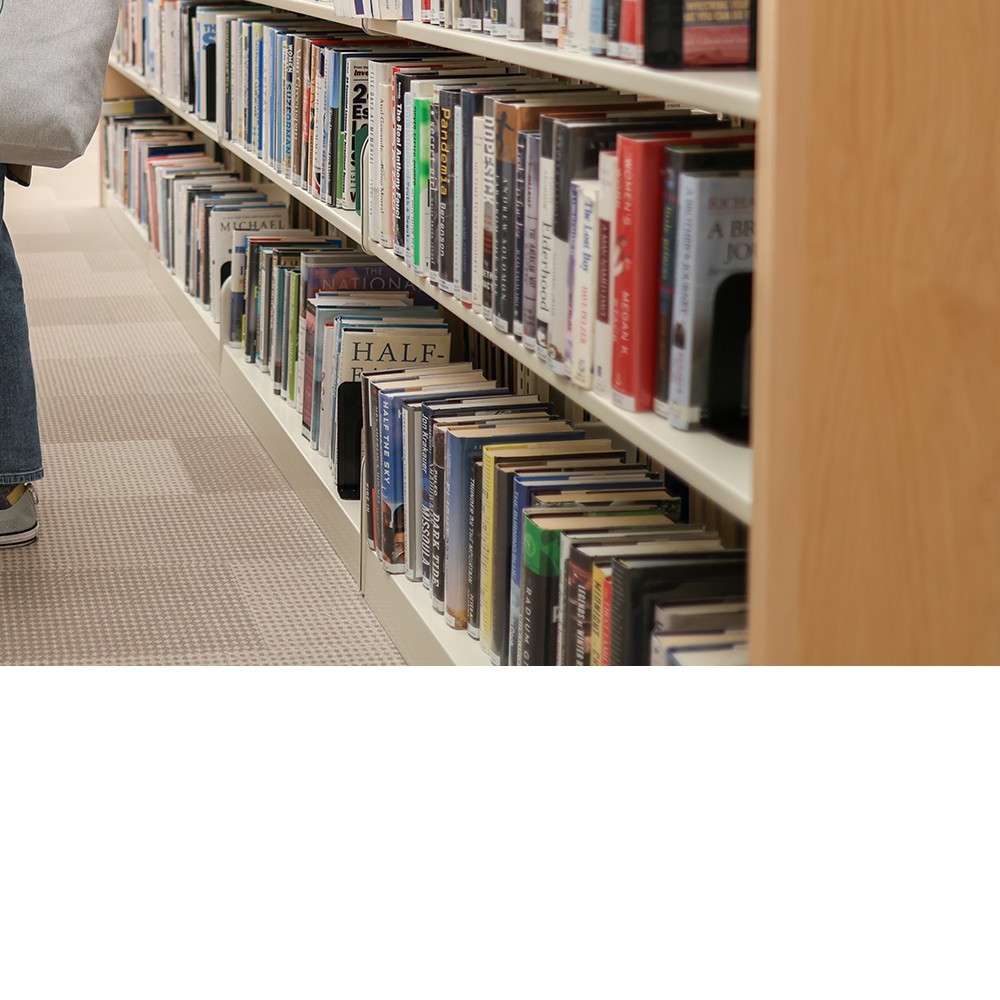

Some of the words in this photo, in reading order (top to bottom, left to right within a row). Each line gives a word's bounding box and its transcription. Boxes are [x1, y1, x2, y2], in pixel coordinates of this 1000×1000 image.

[440, 107, 451, 196] Pandemia
[484, 116, 494, 204] DOPESICK
[623, 158, 633, 225] WOMEN'S
[220, 220, 285, 232] MICHAEL
[584, 201, 594, 219] The
[583, 225, 592, 248] Lost
[682, 198, 693, 259] BROTHER'S
[708, 222, 723, 238] A
[730, 221, 754, 237] BR
[540, 222, 552, 312] Elderhood
[580, 252, 592, 273] Boy
[680, 263, 690, 315] JOURNEY
[620, 291, 630, 340] MEGAN
[352, 342, 444, 362] HALF-
[422, 504, 430, 566] MISSOULA
[469, 516, 474, 526] ON
[432, 554, 440, 587] TIDE
[524, 588, 532, 644] RADIUM
[577, 584, 586, 618] LEGENDS
[594, 580, 602, 639] MIDNIGHT
[603, 601, 611, 628] FIRST
[576, 629, 586, 658] WINTER
